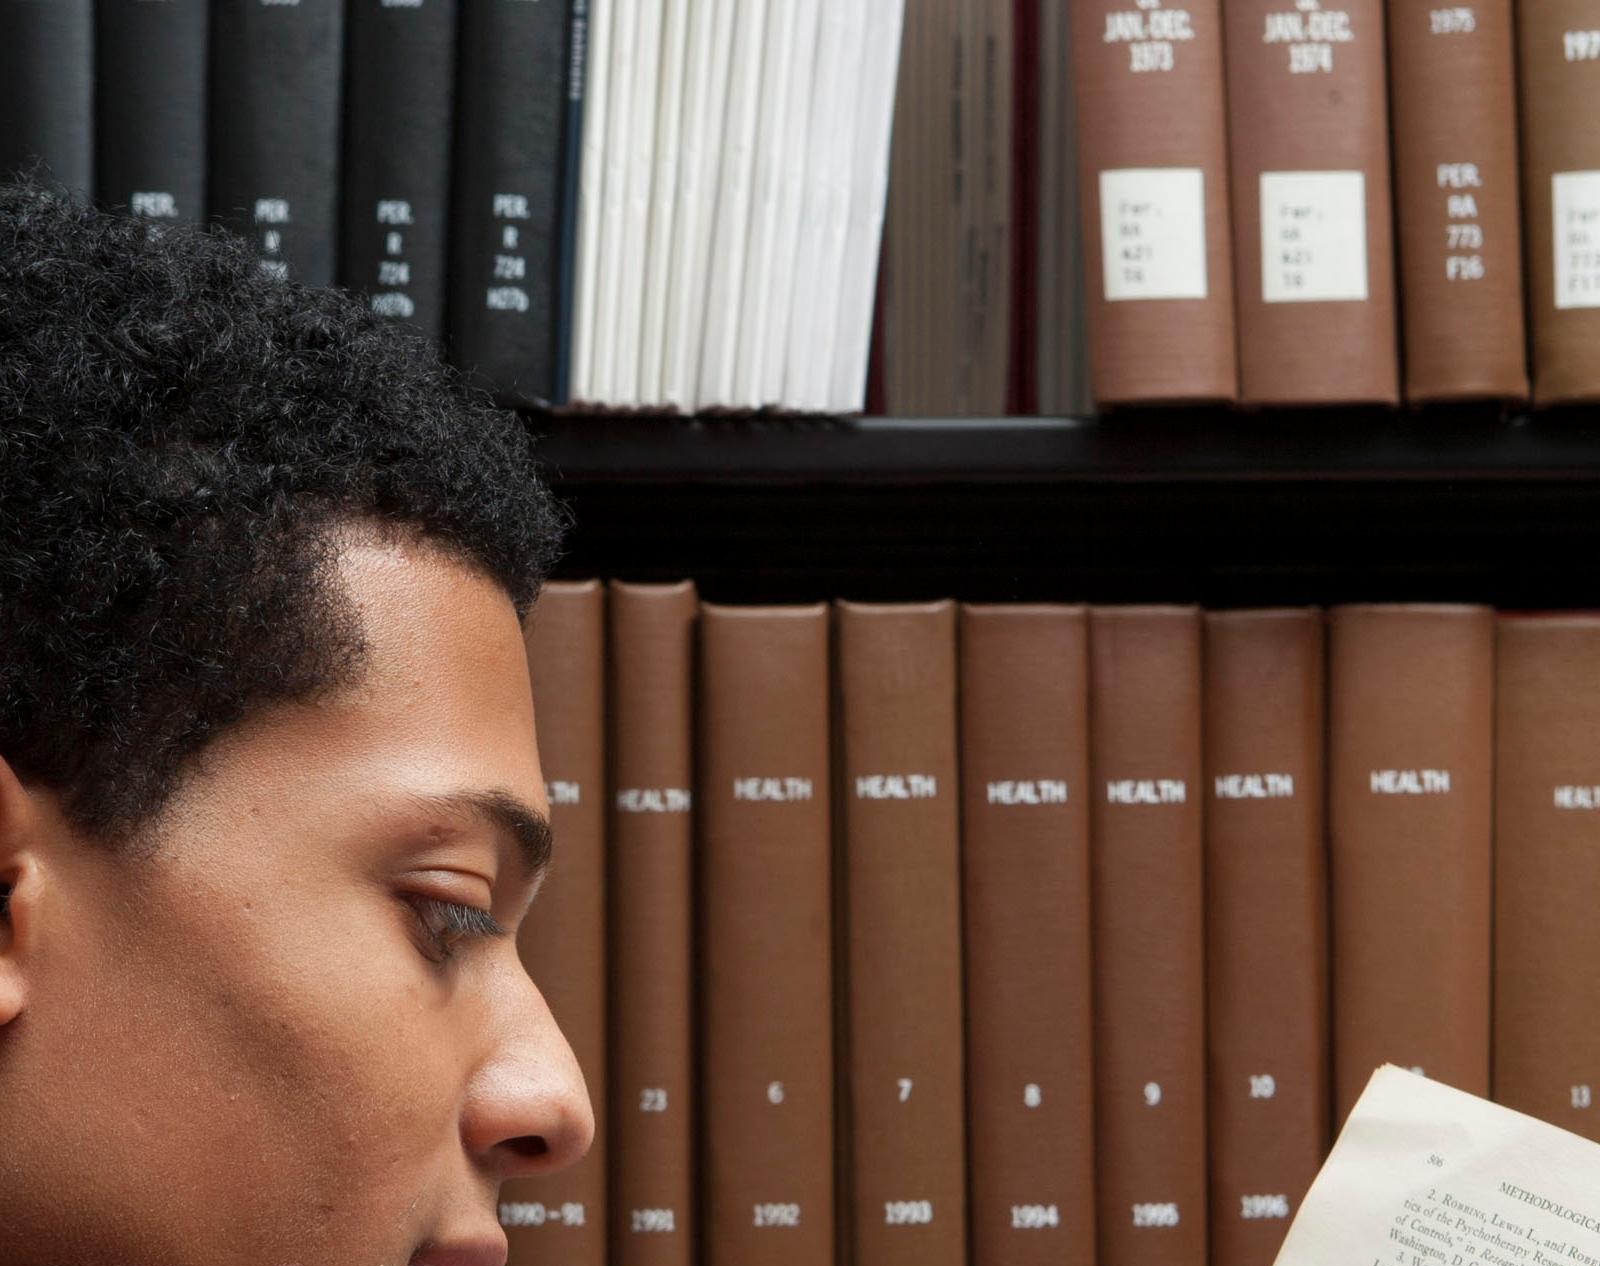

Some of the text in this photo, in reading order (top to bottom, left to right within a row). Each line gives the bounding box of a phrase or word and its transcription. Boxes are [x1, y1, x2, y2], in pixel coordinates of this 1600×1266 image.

[1447, 193, 1478, 218] RA
[1446, 223, 1484, 249] 773
[734, 777, 813, 801] HEALTH
[856, 773, 937, 799] HEALTH
[987, 779, 1068, 805] HEALTH
[1107, 779, 1186, 804] HEALTH
[1215, 773, 1294, 799] HEALTH
[1370, 769, 1451, 794] HEALTH
[619, 787, 691, 813] HEALTH
[767, 1081, 784, 1105] 6
[897, 1078, 913, 1102] 7
[1024, 1083, 1042, 1108] 8
[1143, 1082, 1162, 1106] 9
[1249, 1074, 1276, 1099] 10
[1454, 1217, 1531, 1259] Psychotherapy
